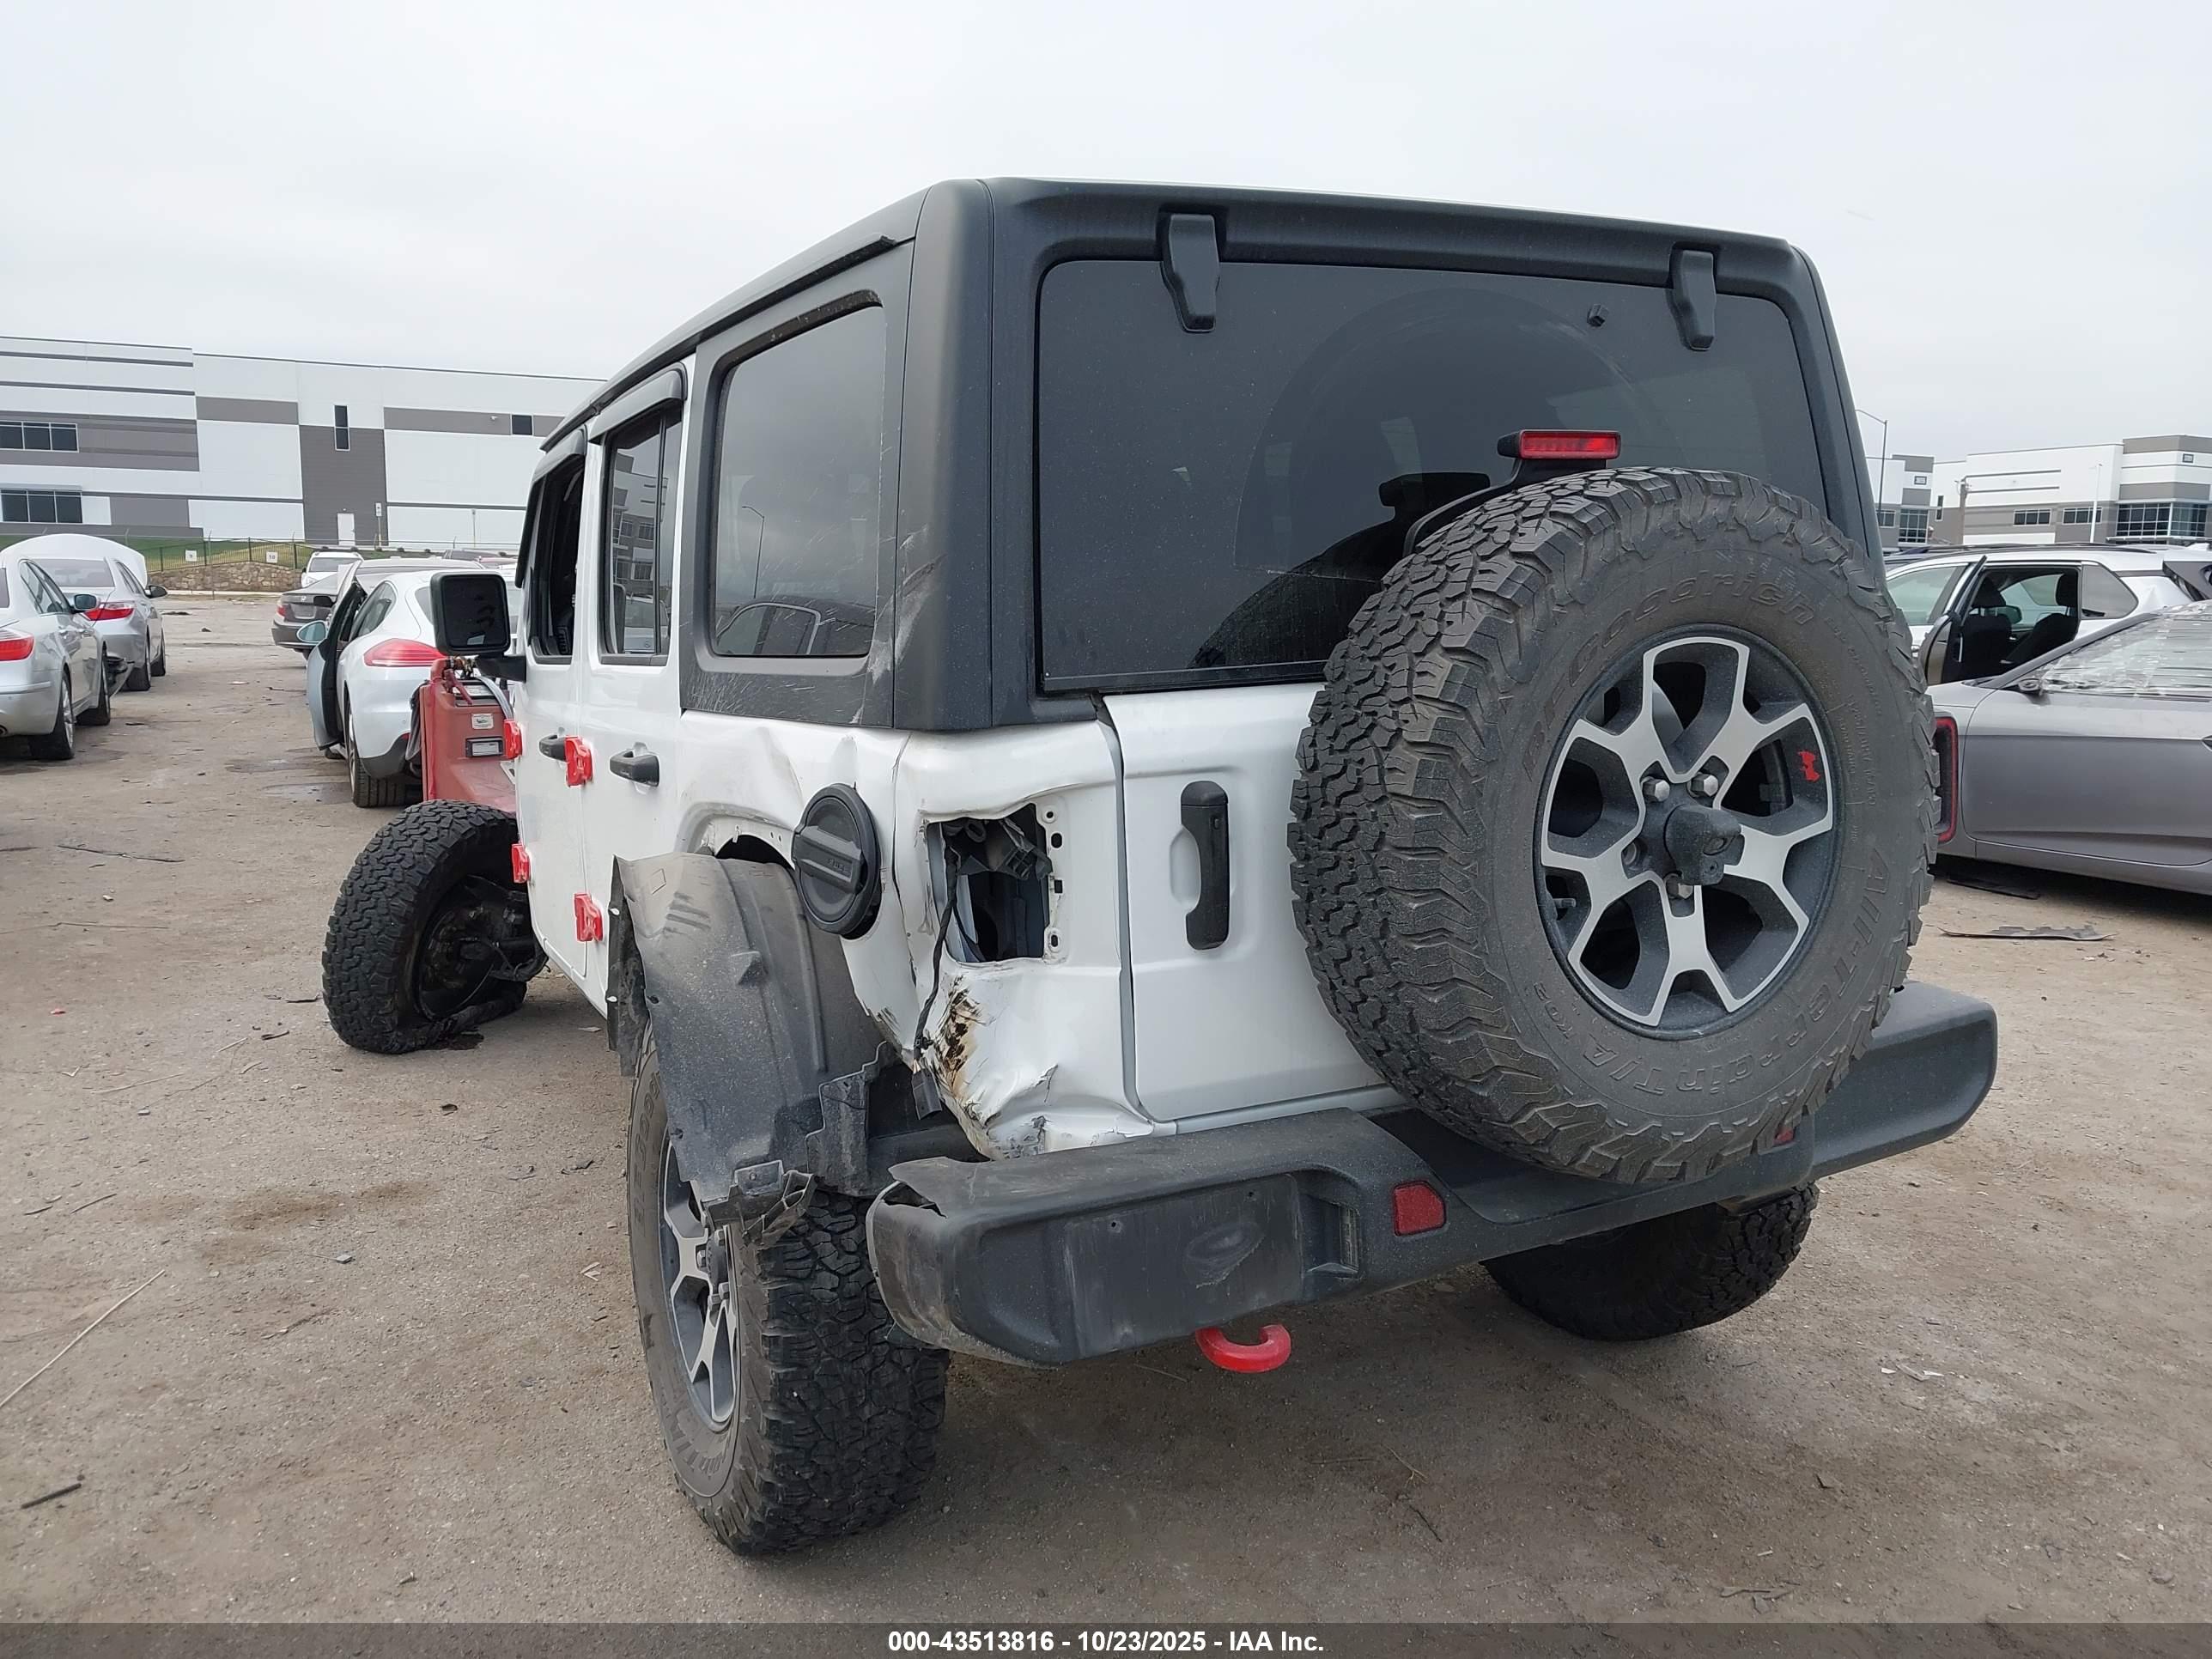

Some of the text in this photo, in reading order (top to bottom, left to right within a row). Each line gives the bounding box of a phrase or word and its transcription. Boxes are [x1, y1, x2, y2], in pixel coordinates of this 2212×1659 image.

[1522, 570, 1815, 782] BFGoodrich
[829, 859, 849, 874] FUEL
[1534, 981, 1579, 1039] KO2
[1583, 1032, 1665, 1096] T/A
